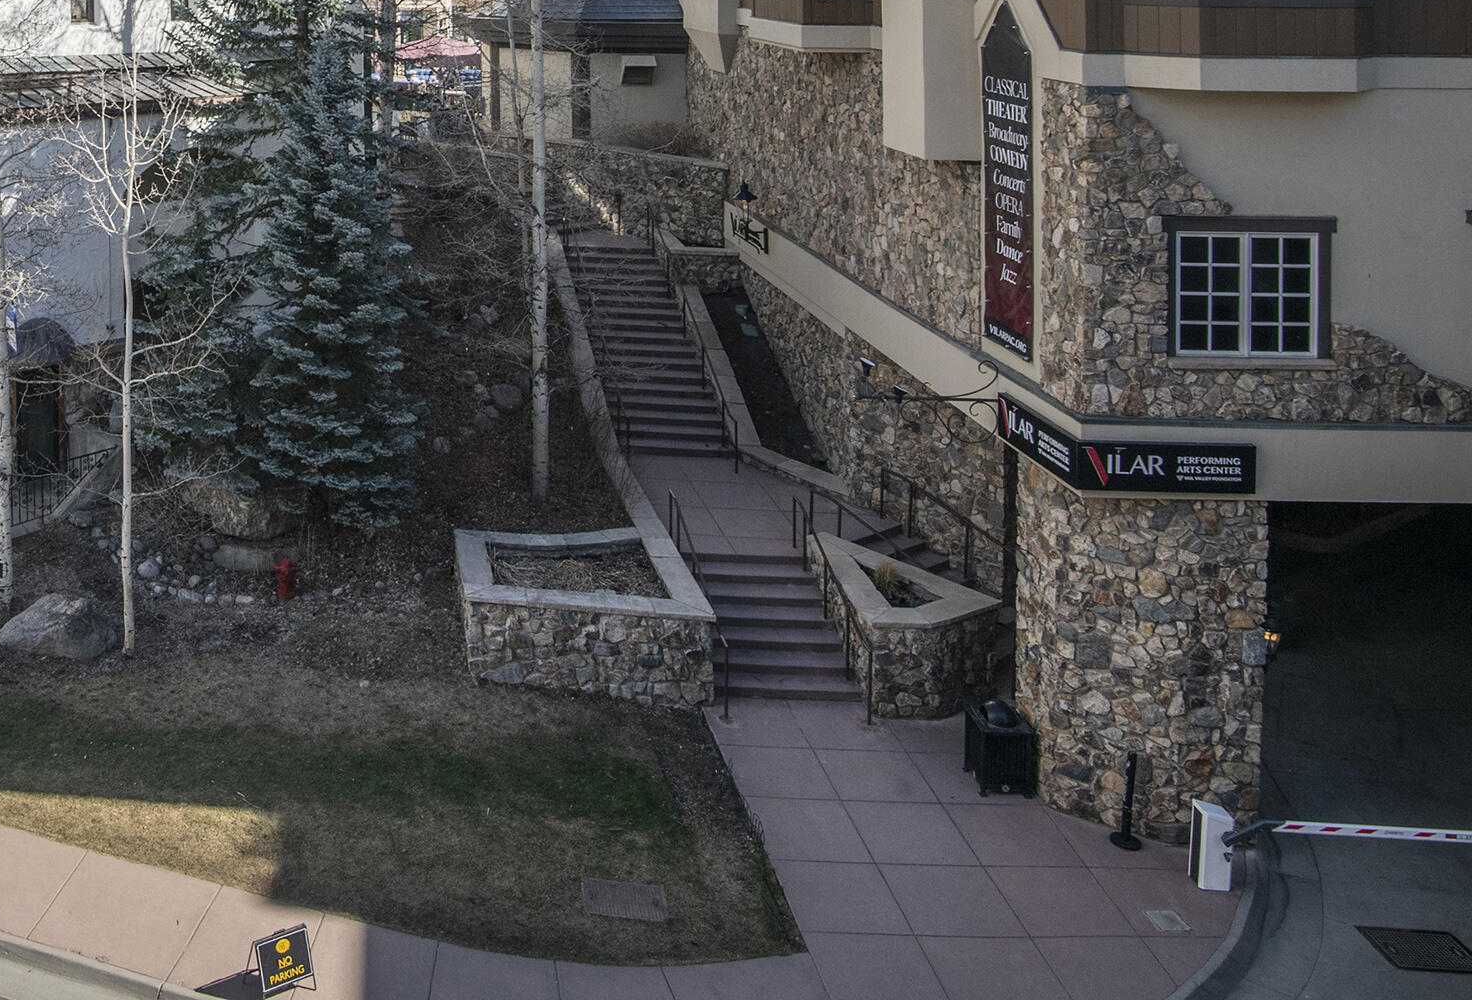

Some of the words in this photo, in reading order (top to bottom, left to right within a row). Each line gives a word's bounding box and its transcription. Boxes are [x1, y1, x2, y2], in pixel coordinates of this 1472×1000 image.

[984, 75, 1029, 100] CLASSICAL
[986, 98, 1028, 124] THEATER
[988, 121, 1028, 151] Broadway
[990, 144, 1028, 171] COMEDY
[993, 168, 1026, 194] Concerts
[995, 191, 1024, 217] OPERA
[996, 215, 1022, 244] Family
[996, 238, 1024, 264] Dance
[1000, 263, 1018, 285] Jazz
[989, 323, 1027, 353] VILARPAC.ORG
[1082, 447, 1166, 487] VILAR
[1176, 465, 1202, 474] ARTS
[1202, 466, 1242, 475] CENTER
[1177, 456, 1241, 466] PERFORMING
[269, 964, 305, 985] PARKING
[278, 955, 293, 970] NO
